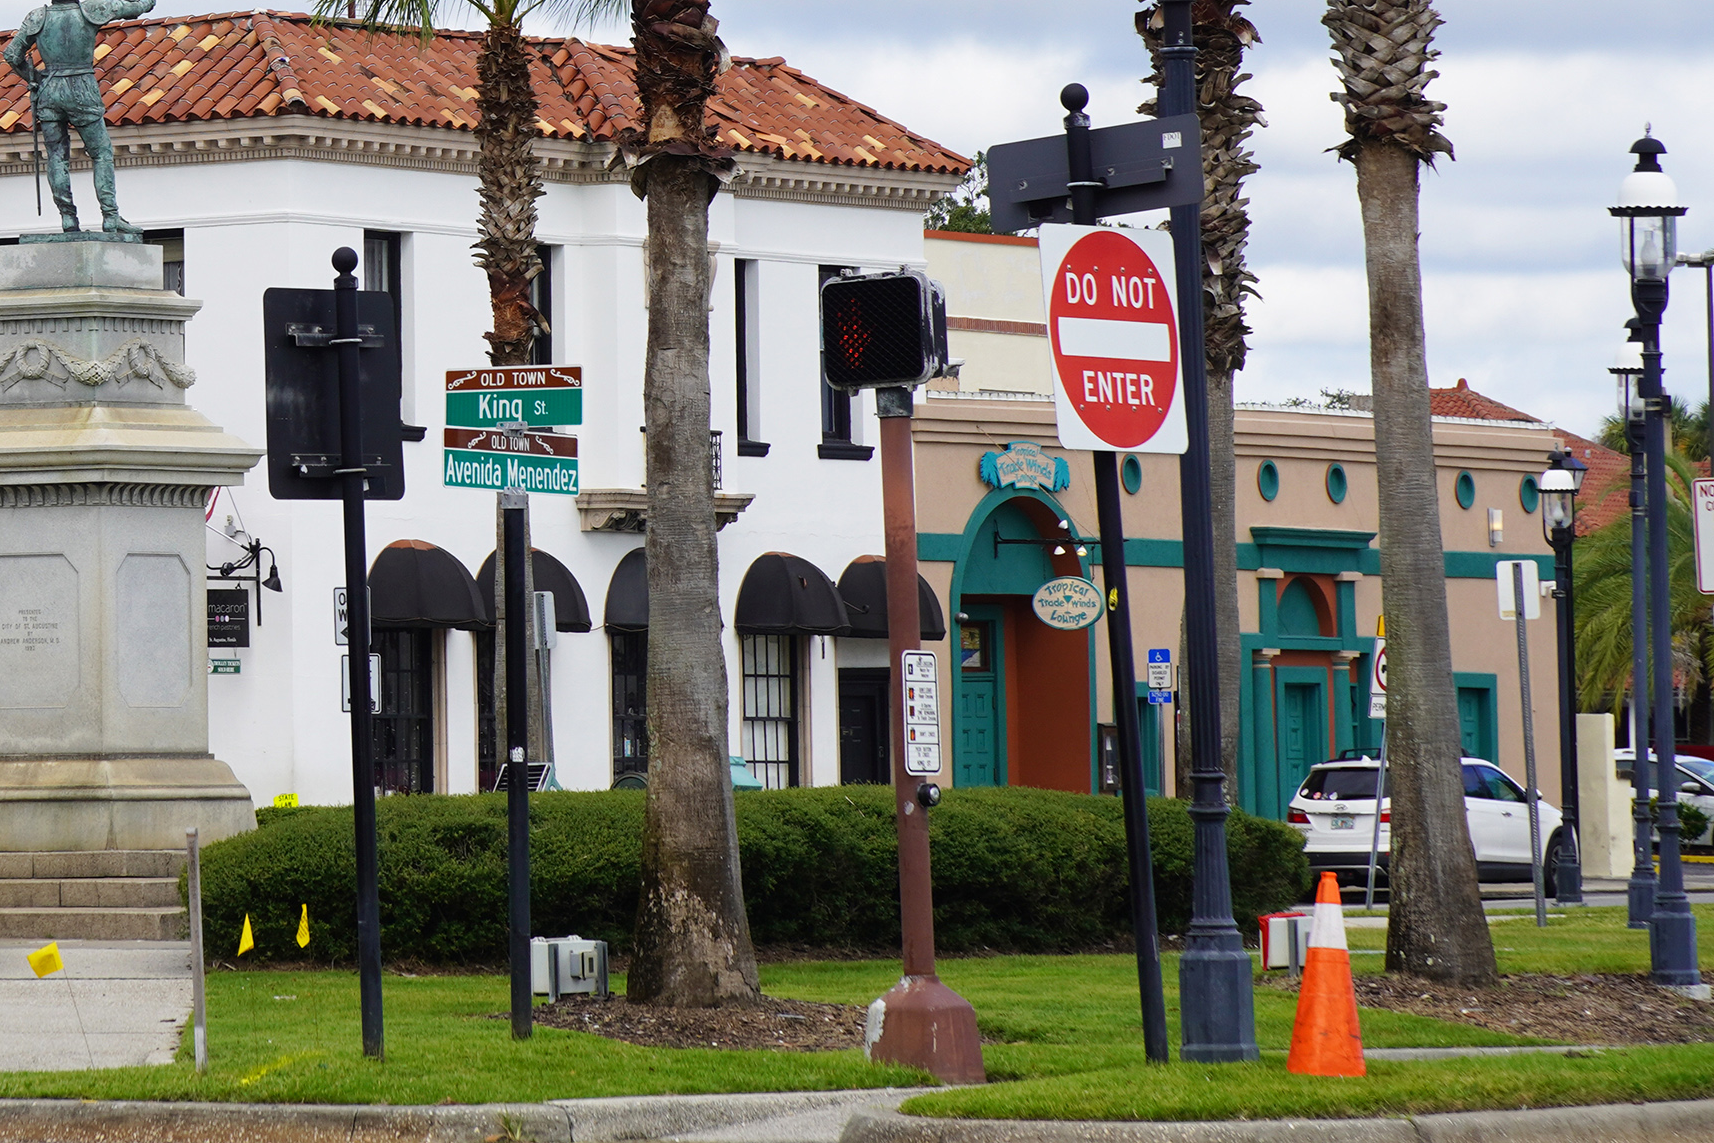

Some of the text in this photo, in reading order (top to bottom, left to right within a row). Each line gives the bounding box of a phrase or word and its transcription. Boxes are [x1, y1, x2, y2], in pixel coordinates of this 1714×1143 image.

[1065, 272, 1156, 309] DO NOT
[480, 371, 546, 386] OLD TOWN
[1082, 370, 1155, 406] ENTER
[479, 394, 549, 422] King St.
[491, 435, 530, 452] OLD TOWN
[1012, 446, 1039, 459] Tropical
[446, 453, 577, 492] Avenida Menendez
[998, 458, 1052, 480] Trade Winds
[1044, 581, 1090, 597] Tropical
[208, 604, 246, 614] macaron
[1038, 597, 1065, 608] Trade
[1050, 610, 1088, 626] Lounge
[278, 794, 294, 802] STATE
